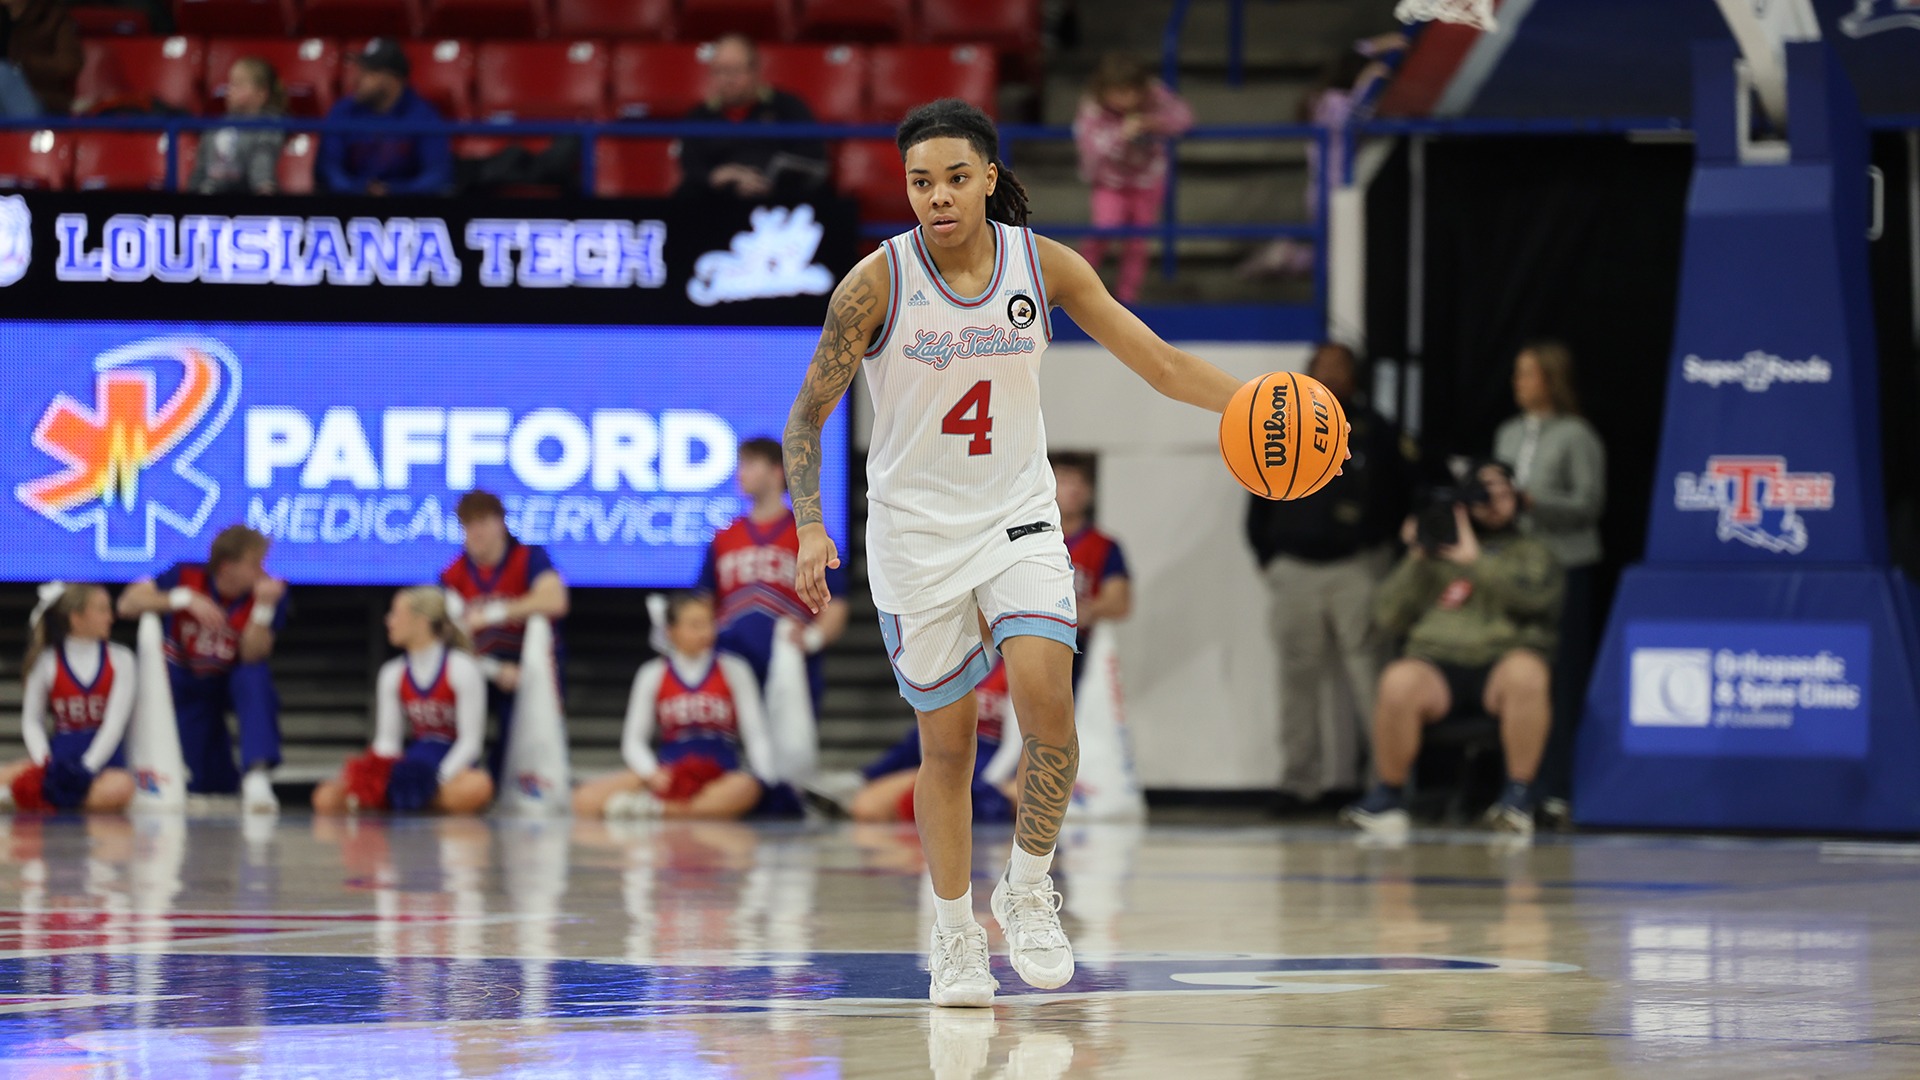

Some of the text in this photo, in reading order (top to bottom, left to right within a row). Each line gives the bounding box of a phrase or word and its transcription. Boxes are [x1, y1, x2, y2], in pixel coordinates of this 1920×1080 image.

[56, 213, 461, 286] LOUISIANA
[466, 218, 667, 288] TECH
[903, 324, 1036, 371] Lady Techsters
[244, 407, 738, 491] PAFFORD
[941, 379, 993, 457] 4
[1263, 384, 1288, 468] Wilson
[503, 495, 741, 546] SERVICES
[717, 546, 798, 592] TECH
